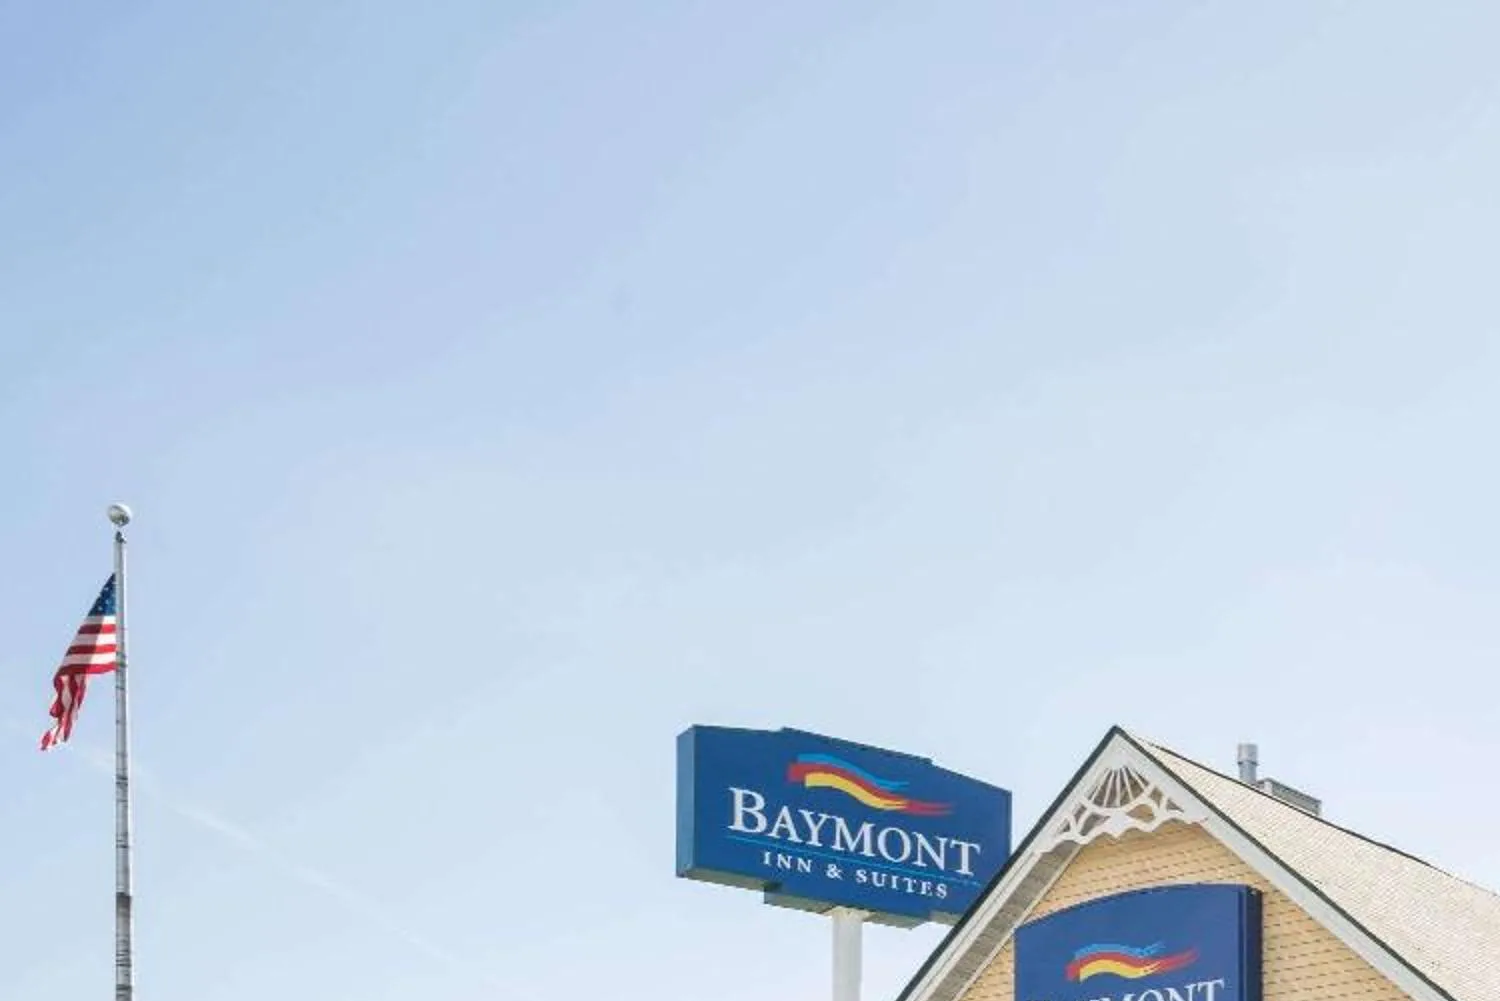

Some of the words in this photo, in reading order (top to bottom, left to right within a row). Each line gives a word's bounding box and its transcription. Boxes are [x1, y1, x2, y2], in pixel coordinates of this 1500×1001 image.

[728, 787, 981, 876] BAYMONT
[763, 851, 812, 874] INN
[826, 863, 843, 881] &
[856, 869, 948, 899] SUITES
